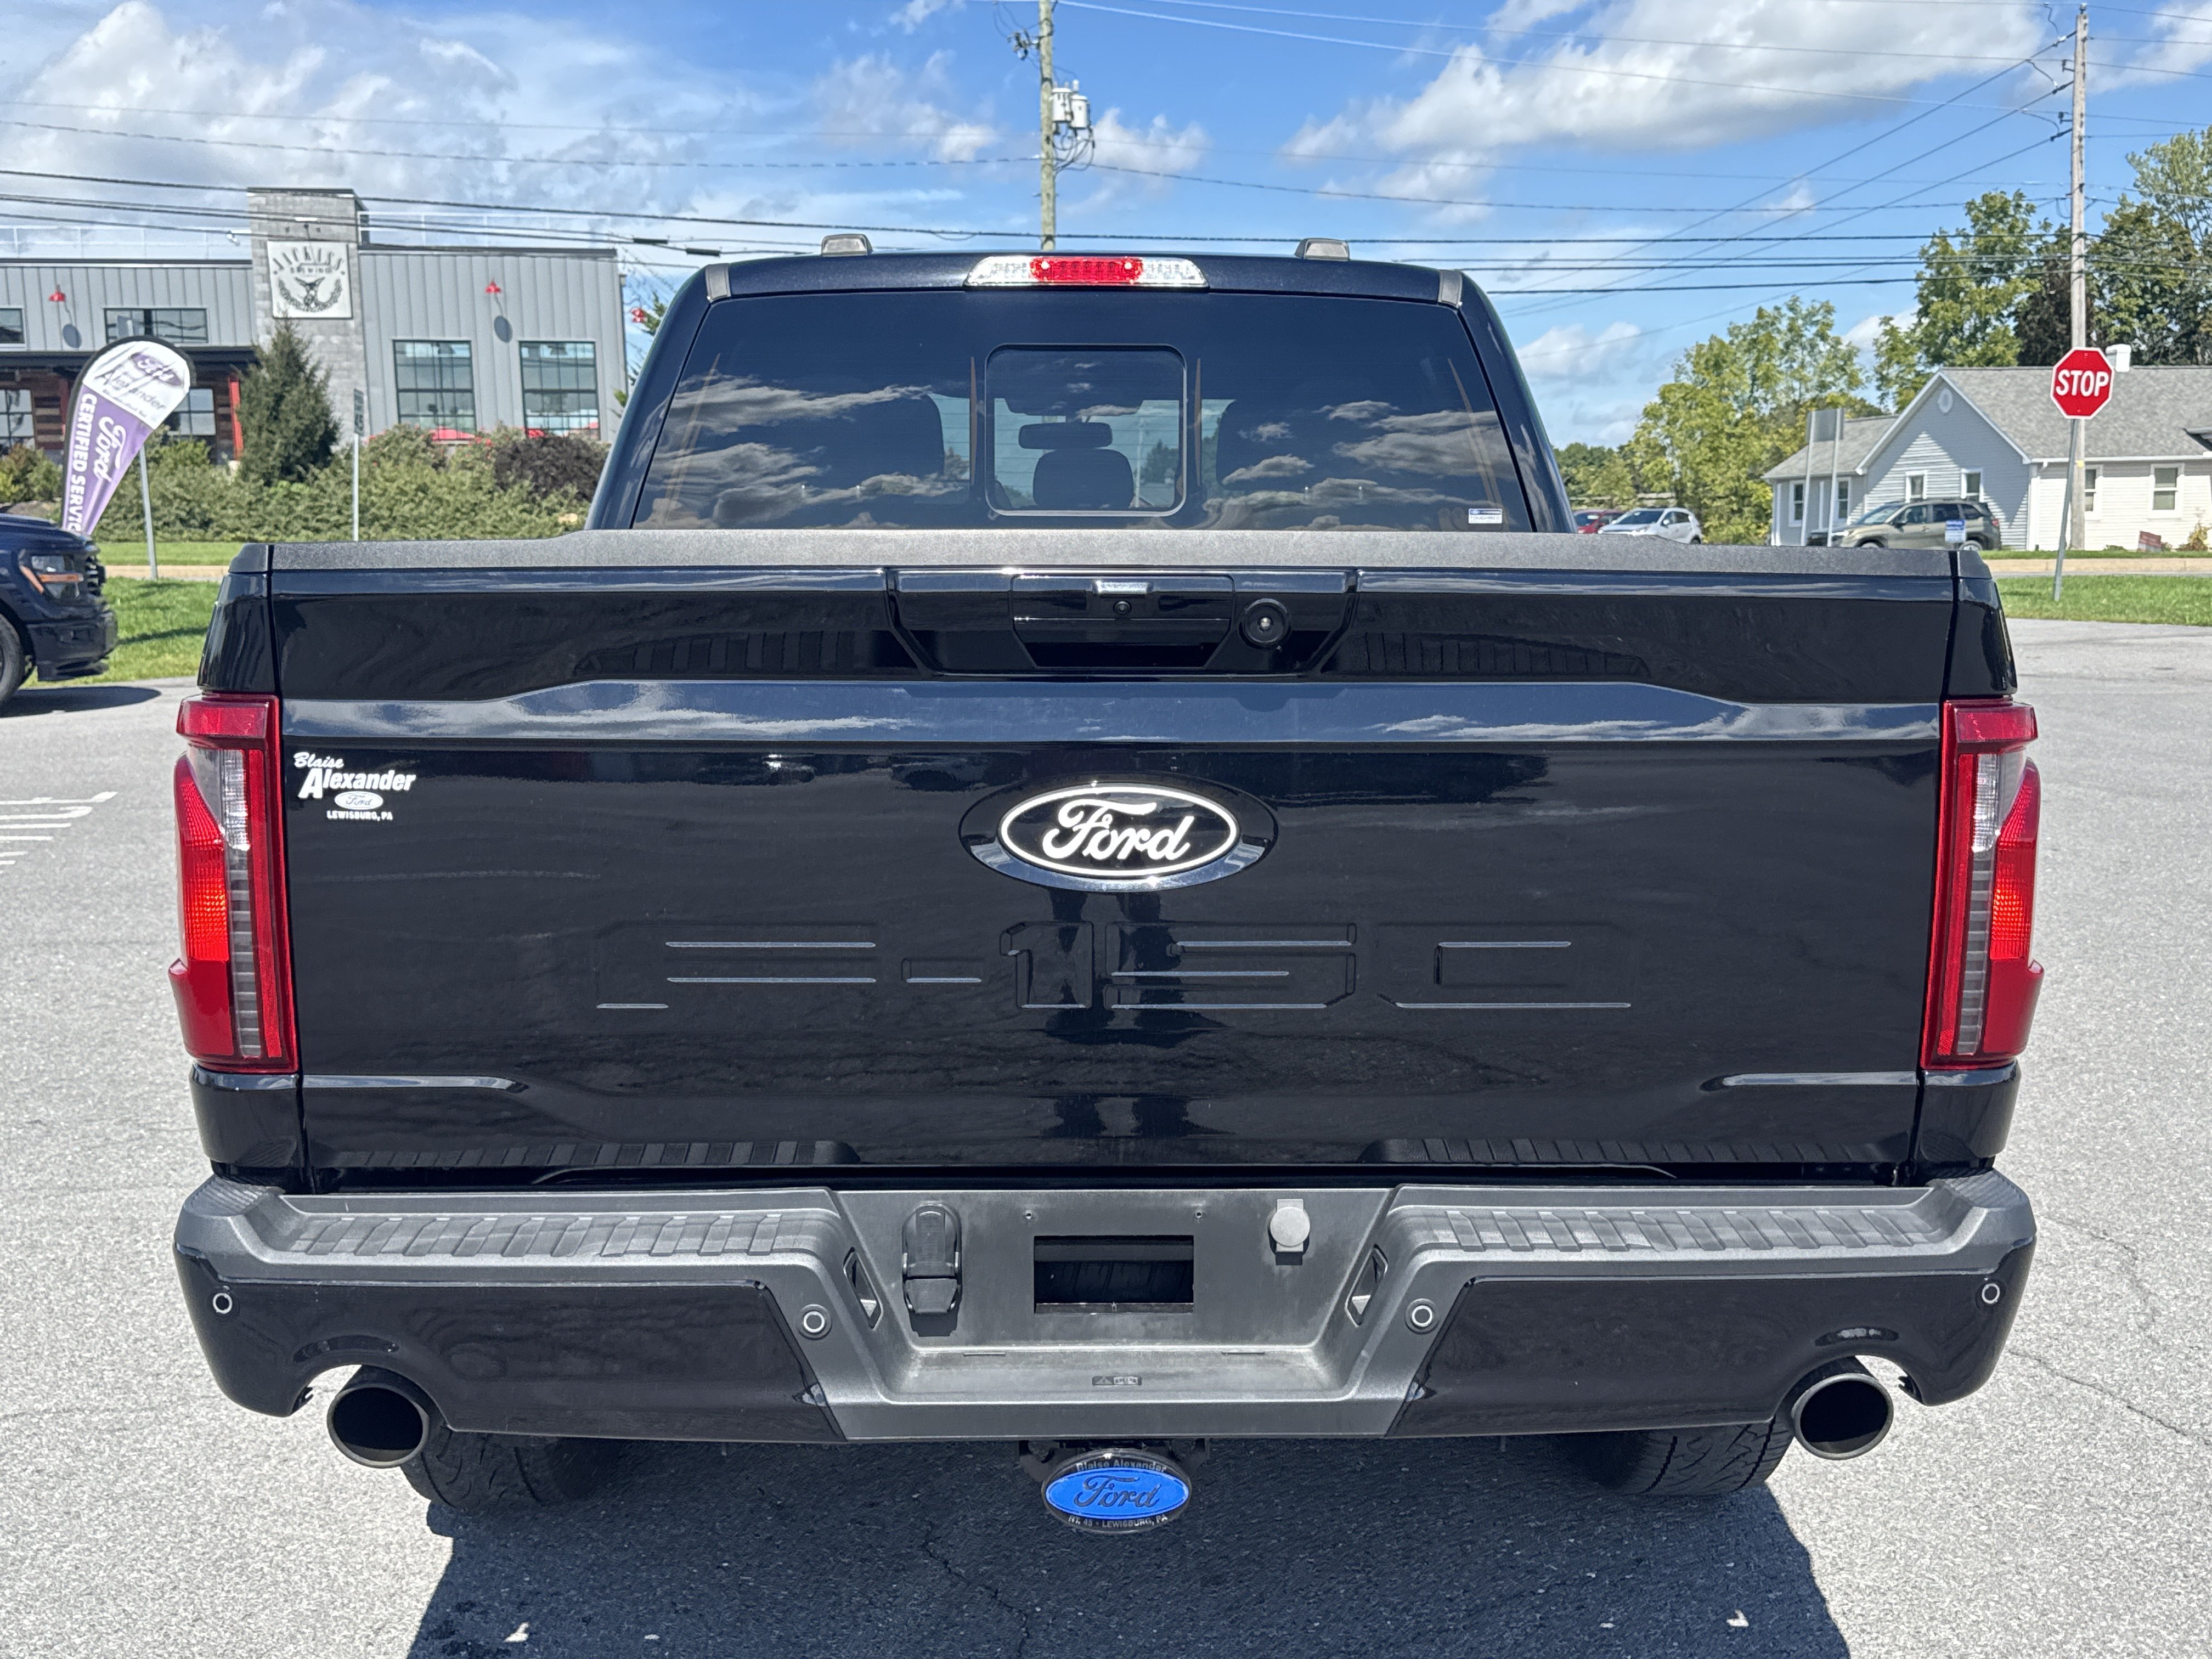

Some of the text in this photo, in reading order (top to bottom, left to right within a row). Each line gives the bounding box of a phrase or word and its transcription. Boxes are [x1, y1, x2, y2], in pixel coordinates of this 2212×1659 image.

[2055, 369, 2109, 397] STOP
[67, 393, 97, 532] CERTIFIED SERVIC
[93, 416, 126, 482] Ford
[294, 751, 345, 768] Blaise
[298, 768, 416, 799] Alexander
[345, 794, 373, 806] Ford
[380, 811, 393, 820] PA
[1042, 798, 1195, 860] Ford
[596, 920, 1637, 1010] F-150
[1113, 1459, 1167, 1472] Alexander
[1073, 1475, 1162, 1508] Ford
[1155, 1514, 1169, 1523] PA
